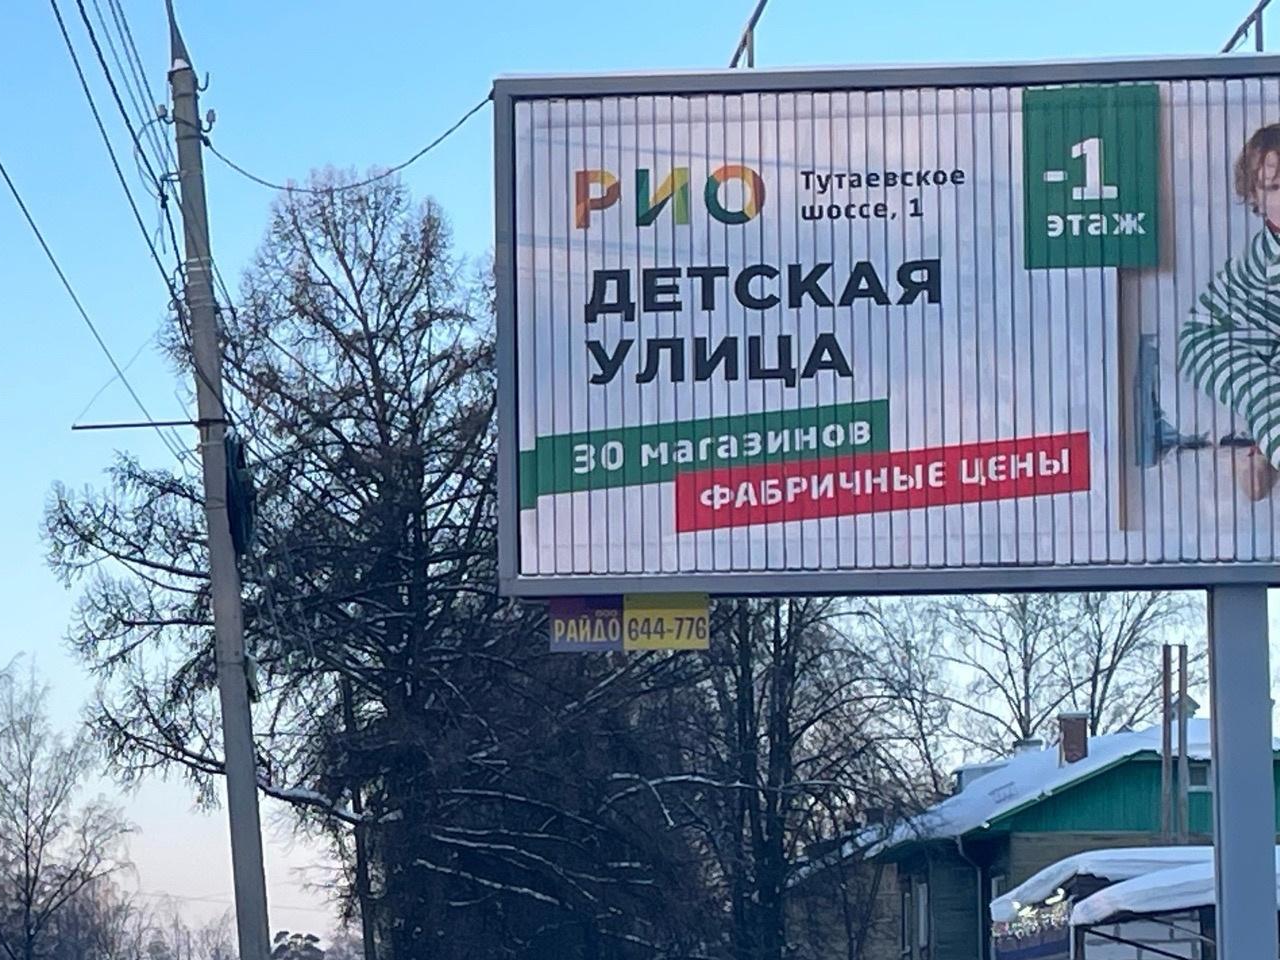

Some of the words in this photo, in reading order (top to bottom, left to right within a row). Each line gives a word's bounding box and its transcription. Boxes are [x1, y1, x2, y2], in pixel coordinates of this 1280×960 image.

[800, 167, 966, 194] Тутаевское
[1043, 137, 1118, 200] -1
[574, 165, 766, 230] РИО
[801, 200, 898, 221] шоссе,
[908, 198, 925, 217] 1
[1047, 212, 1146, 237] этаж
[585, 259, 942, 324] ДЕТСКАЯ
[585, 333, 853, 388] УЛИЦА
[573, 440, 624, 474] 30
[641, 420, 872, 467] магазинов
[700, 461, 946, 510] ФАБРИЧНЫЕ
[961, 448, 1070, 487] ЦЕНЫ
[554, 615, 620, 643] РАЙДО
[627, 617, 707, 641] 644-776
